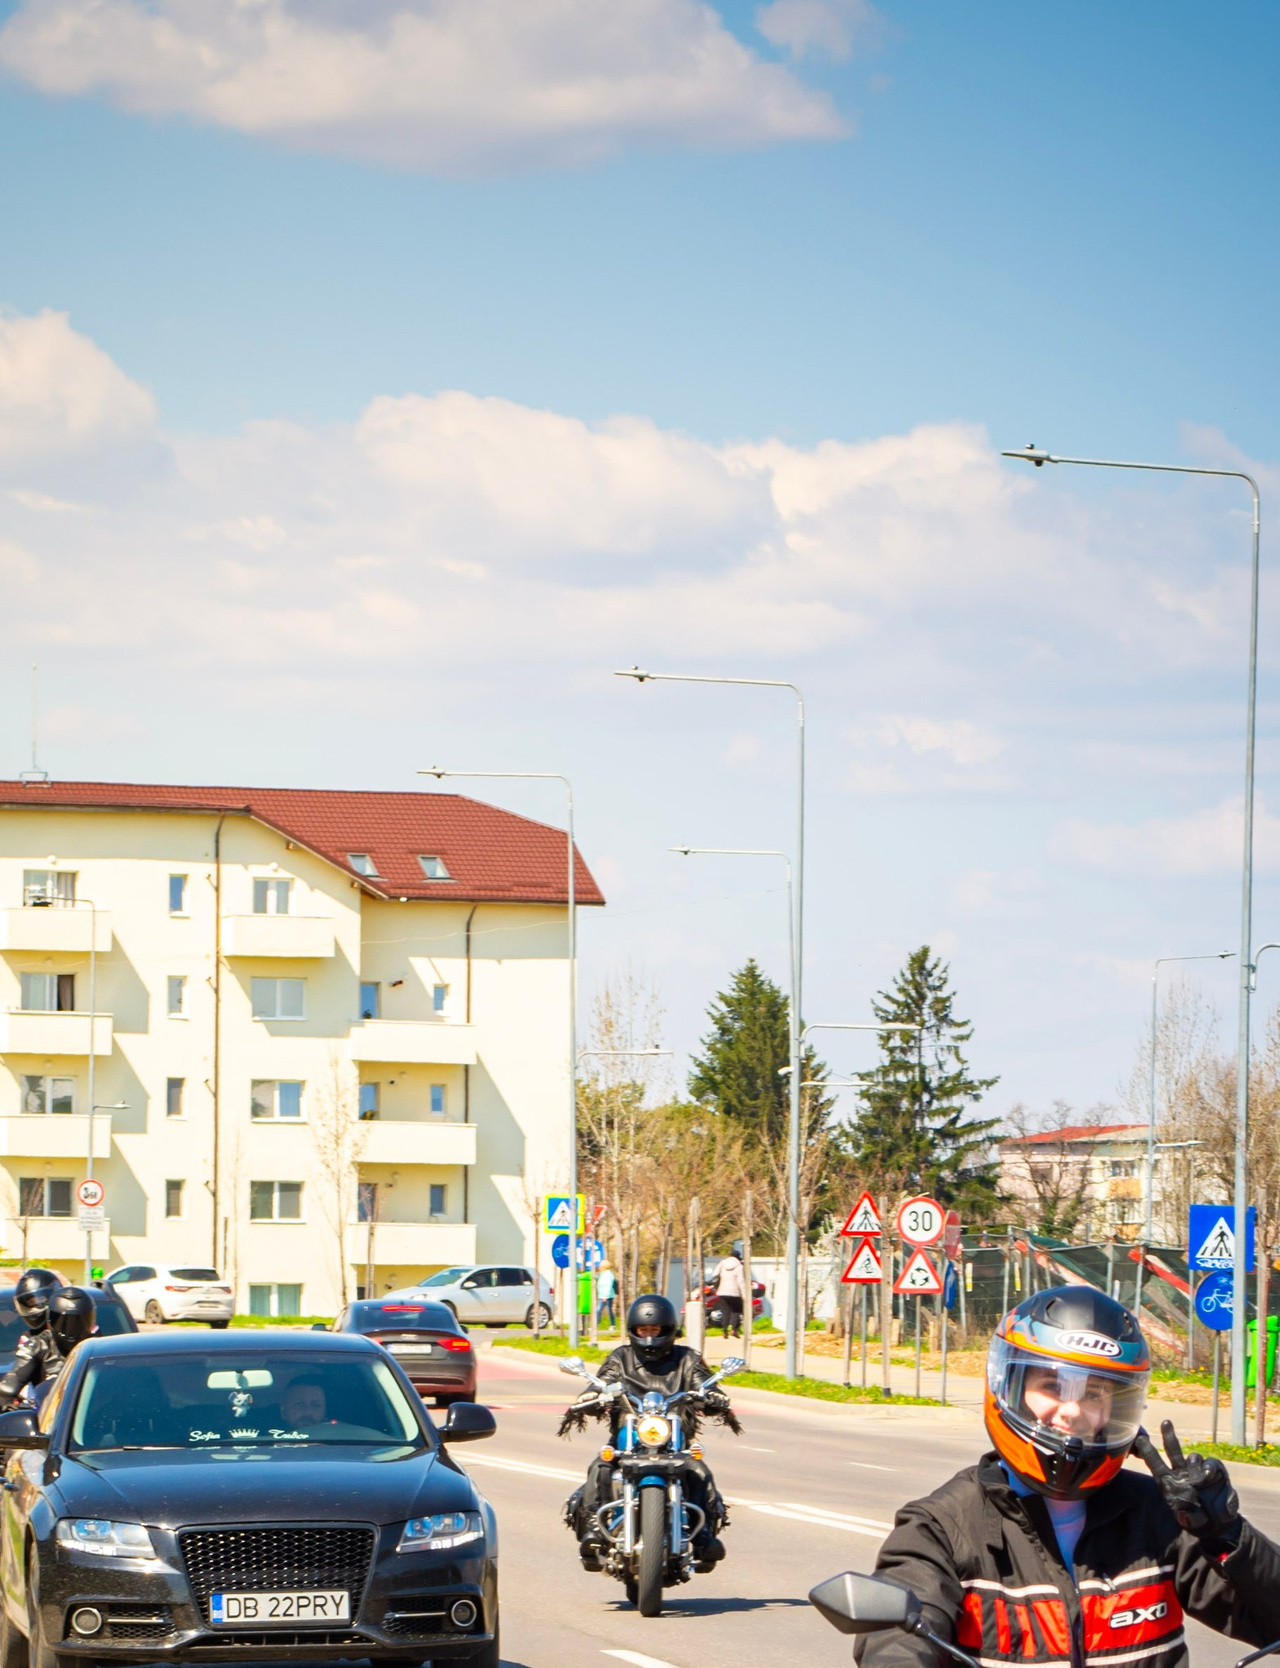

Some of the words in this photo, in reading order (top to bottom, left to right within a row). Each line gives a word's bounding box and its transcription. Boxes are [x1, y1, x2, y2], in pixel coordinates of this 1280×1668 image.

[908, 1210, 933, 1232] 30
[1066, 1335, 1115, 1354] HJC
[188, 1430, 221, 1442] Sofia
[226, 1597, 259, 1619] DB
[268, 1594, 344, 1618] 22PRY
